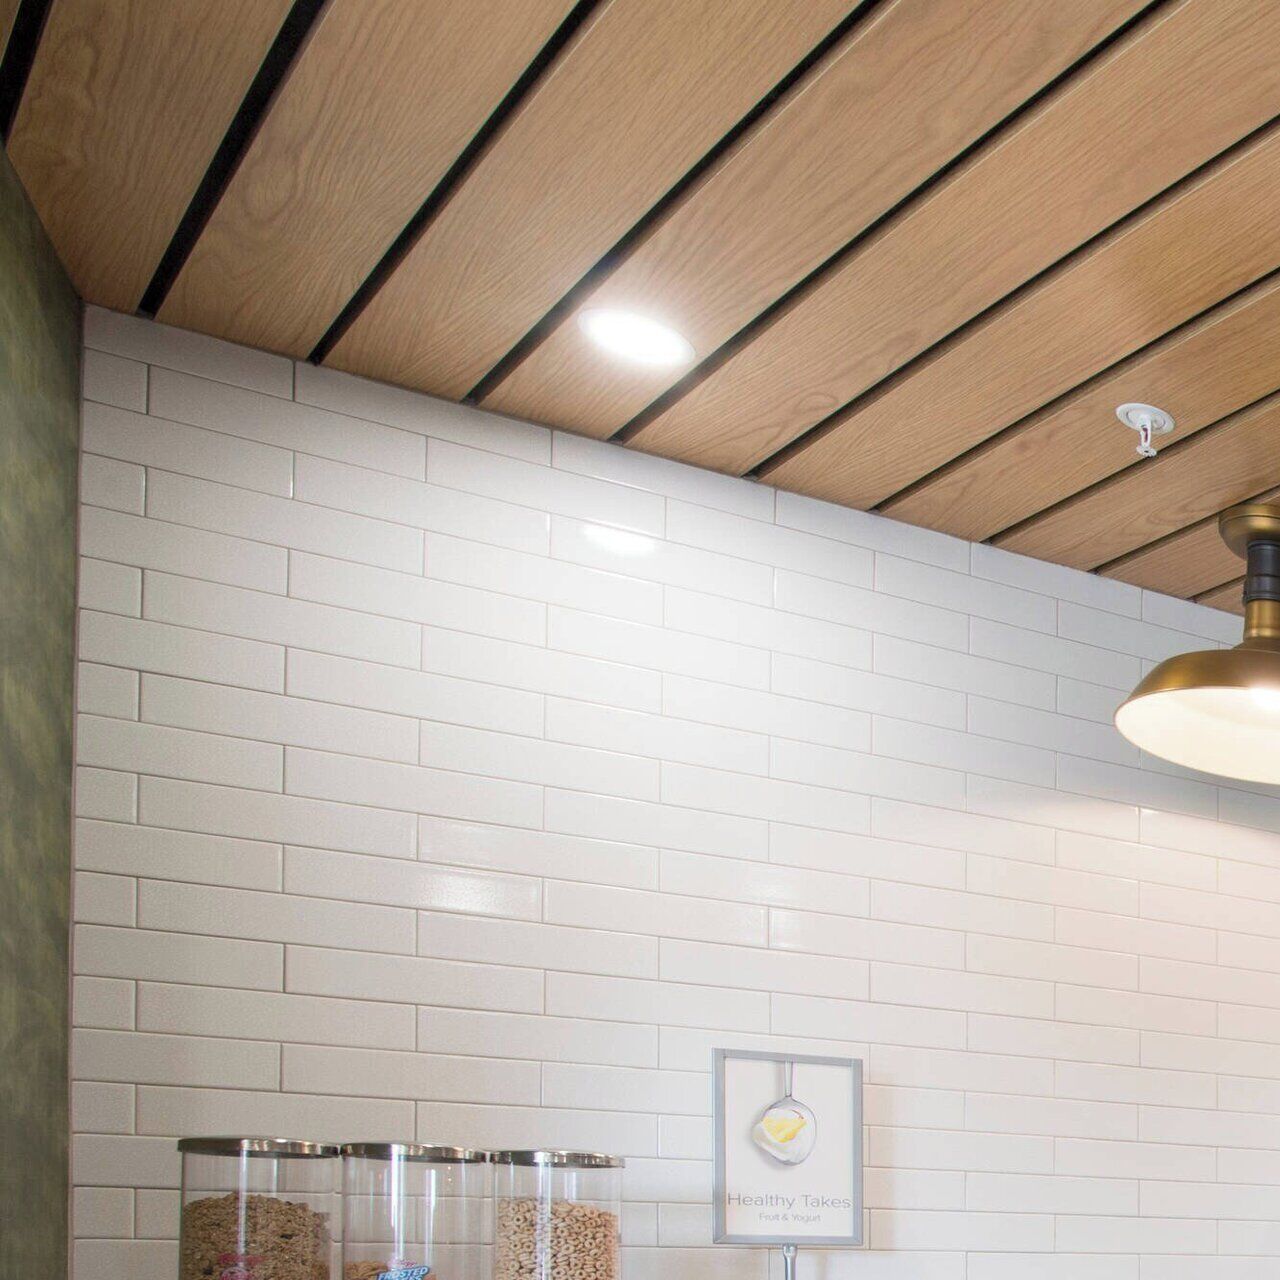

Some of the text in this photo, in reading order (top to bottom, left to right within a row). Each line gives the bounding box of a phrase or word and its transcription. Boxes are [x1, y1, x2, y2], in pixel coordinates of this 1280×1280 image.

[727, 1192, 852, 1210] Healthy Takes
[758, 1213, 780, 1222] Fruit
[791, 1213, 821, 1224] Yogurt
